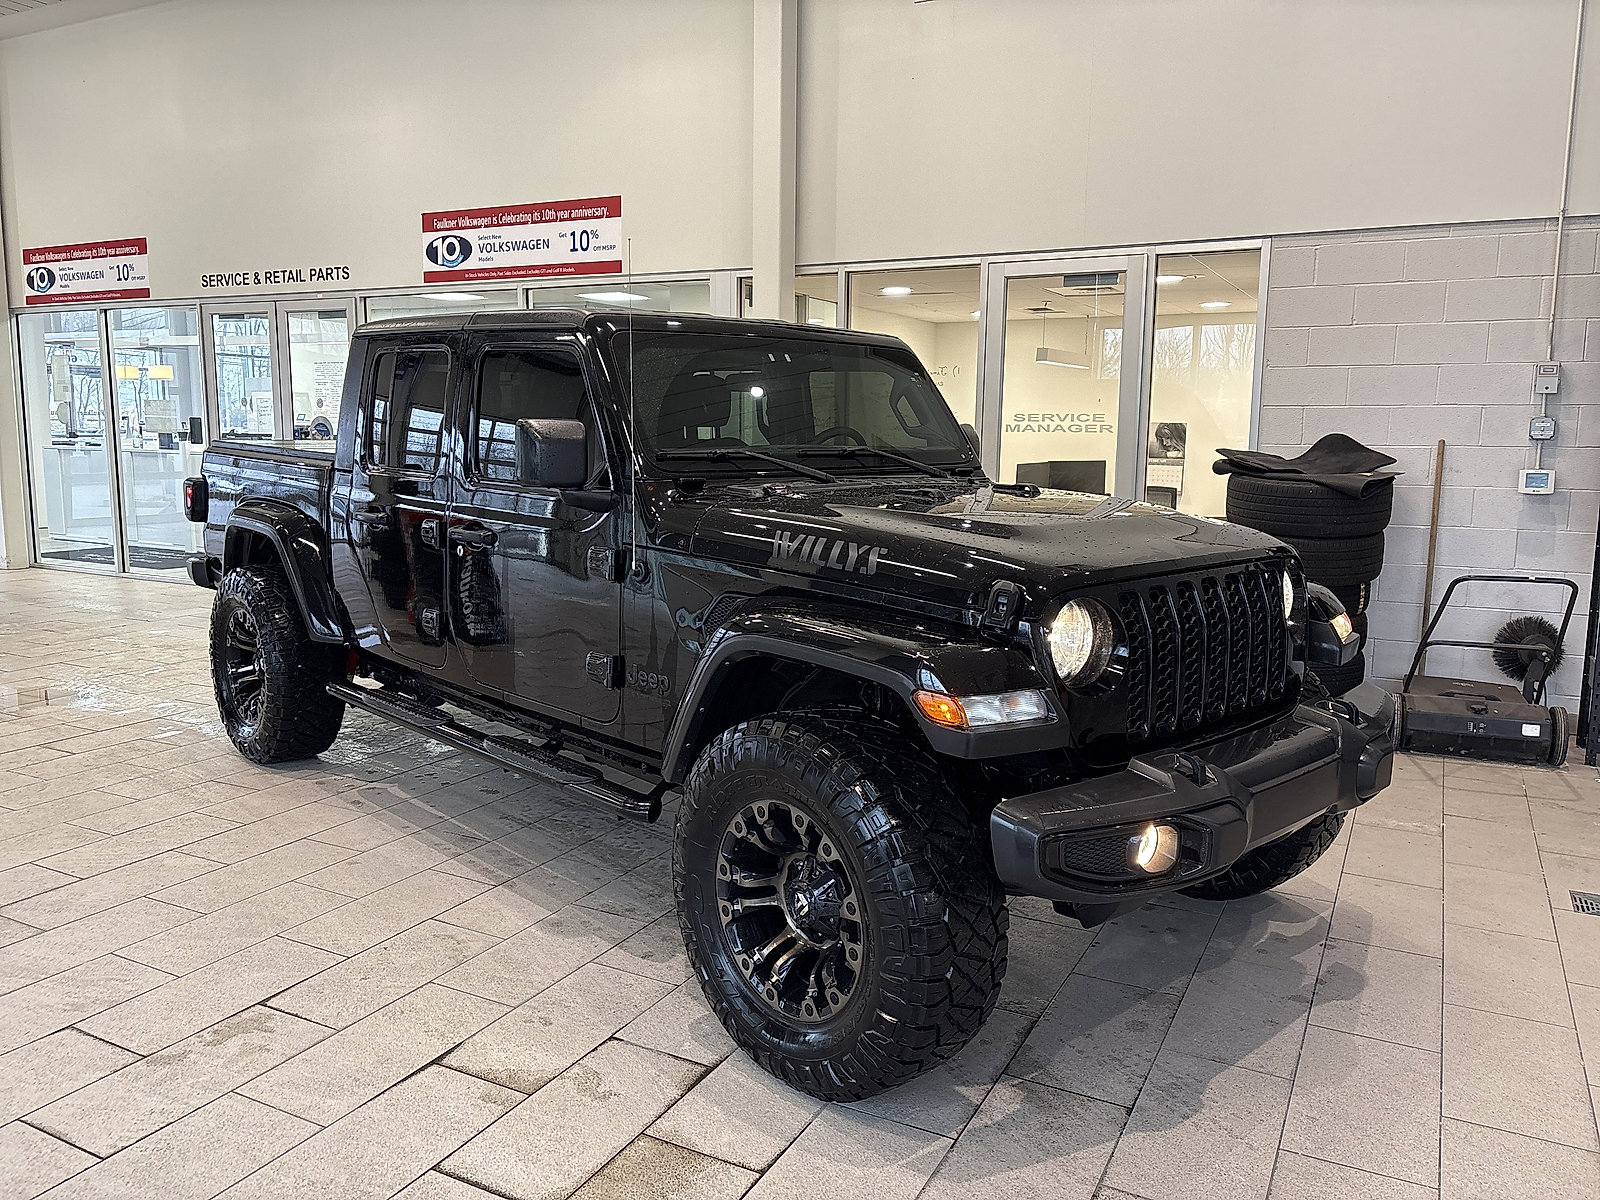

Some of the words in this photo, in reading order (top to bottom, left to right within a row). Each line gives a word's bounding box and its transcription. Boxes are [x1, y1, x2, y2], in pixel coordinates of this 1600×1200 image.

[433, 217, 457, 229] Faulkner
[457, 215, 491, 228] Volkswagen
[492, 213, 497, 225] is
[498, 211, 532, 224] Celebrating
[541, 208, 556, 220] 10th
[557, 210, 570, 222] year
[570, 205, 609, 218] anniversary.
[432, 236, 461, 265] 10
[478, 238, 550, 253] VOLKSWAGEN
[30, 267, 48, 290] 10
[59, 270, 104, 281] VOLKSWAGEN
[201, 272, 250, 288] SERVICE
[253, 271, 261, 285] &
[264, 269, 306, 284] RETAIL
[309, 266, 350, 281] PARTS
[1005, 424, 1114, 434] MANAGER
[1013, 413, 1106, 423] SERVICE
[771, 530, 888, 576] WILLYS
[627, 663, 670, 696] Jeep
